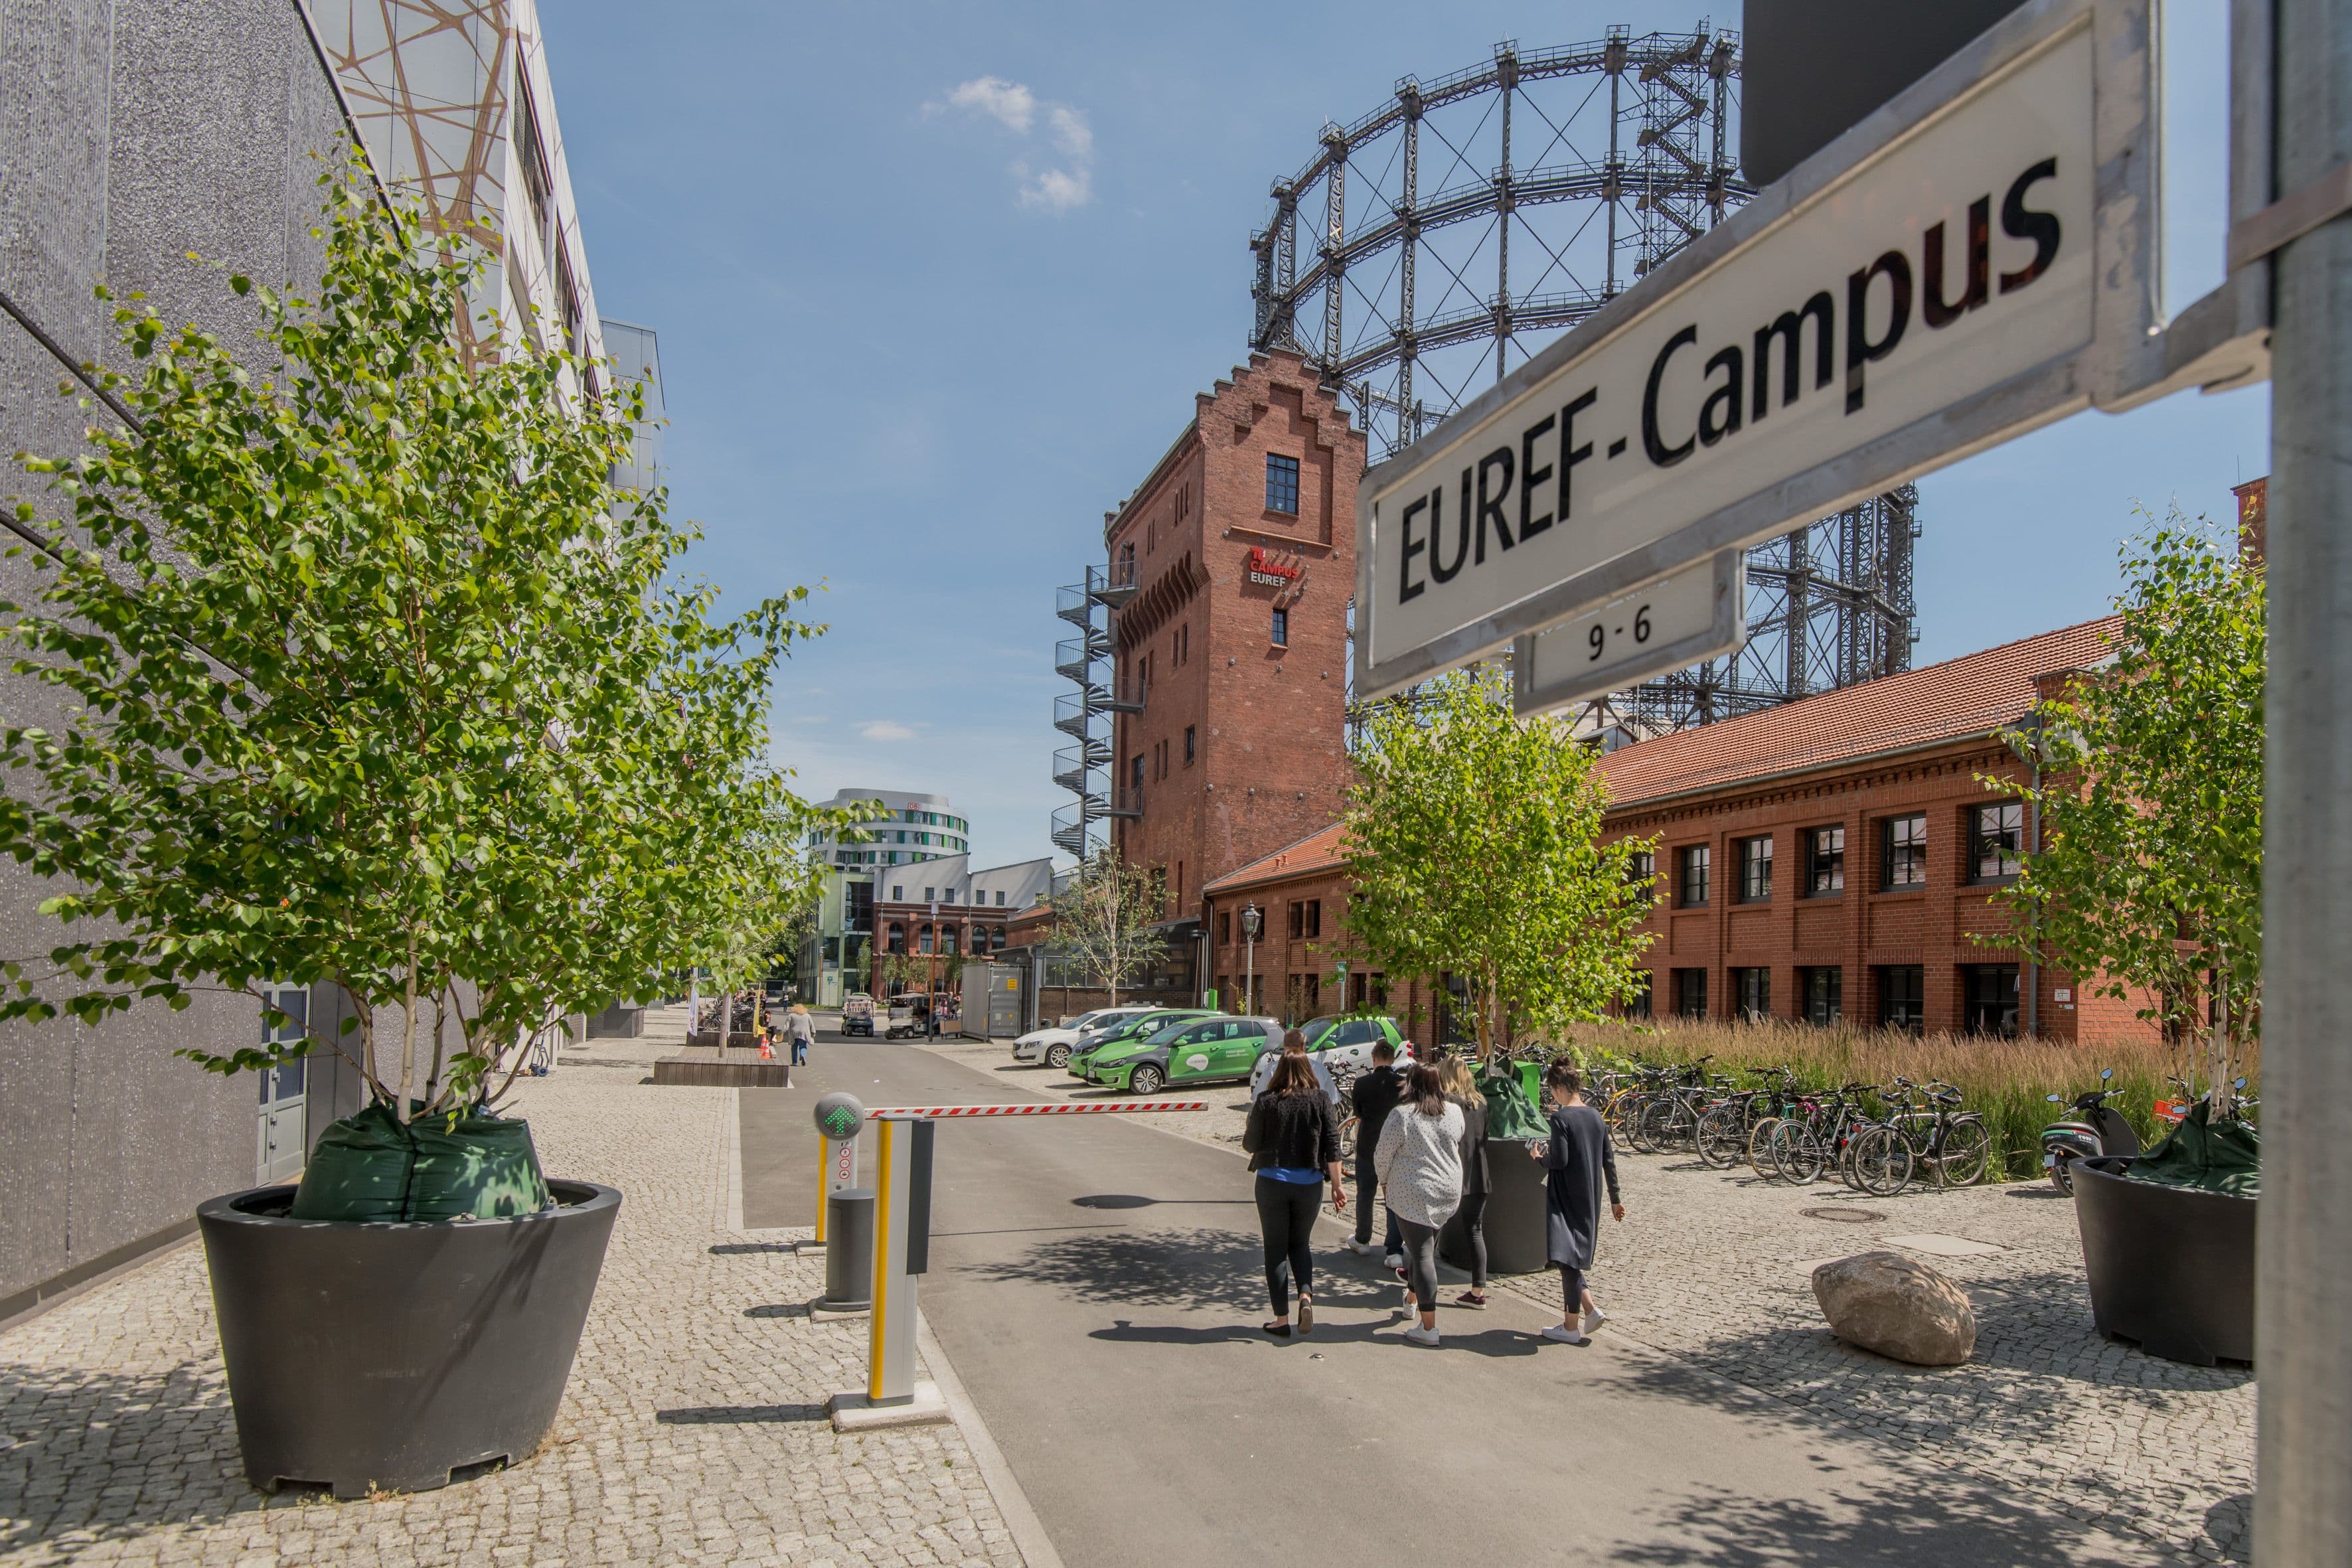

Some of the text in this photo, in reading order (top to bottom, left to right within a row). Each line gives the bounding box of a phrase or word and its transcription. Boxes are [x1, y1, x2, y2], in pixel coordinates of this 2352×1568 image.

[1399, 156, 2060, 604] EUREF-Campus
[1250, 561, 1299, 579] CAMPUS
[1251, 572, 1286, 588] EUREF
